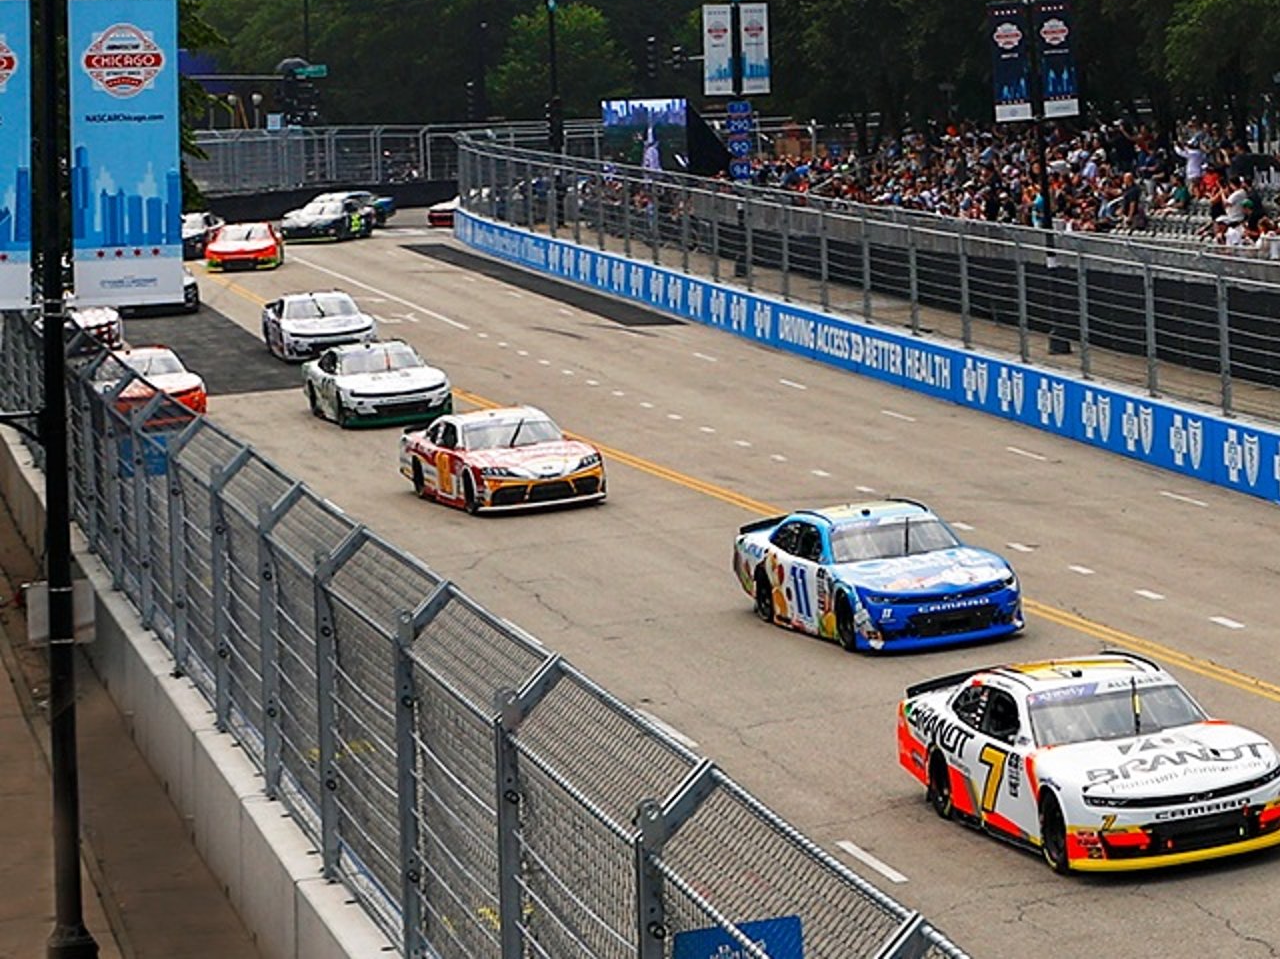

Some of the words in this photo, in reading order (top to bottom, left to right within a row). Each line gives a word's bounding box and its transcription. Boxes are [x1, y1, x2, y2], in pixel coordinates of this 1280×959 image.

[91, 54, 155, 68] CHICAGO
[779, 312, 815, 350] DRIVING
[816, 323, 850, 360] ACCESS
[864, 337, 902, 376] BETTER
[905, 347, 951, 389] HEALTH
[790, 564, 812, 618] 11
[918, 597, 989, 613] CAMARO
[1107, 676, 1163, 689] ALLAIER
[1086, 742, 1269, 783] BRANDT
[979, 743, 1009, 812] 7
[1155, 797, 1251, 820] CAMARO
[1101, 814, 1117, 831] 7
